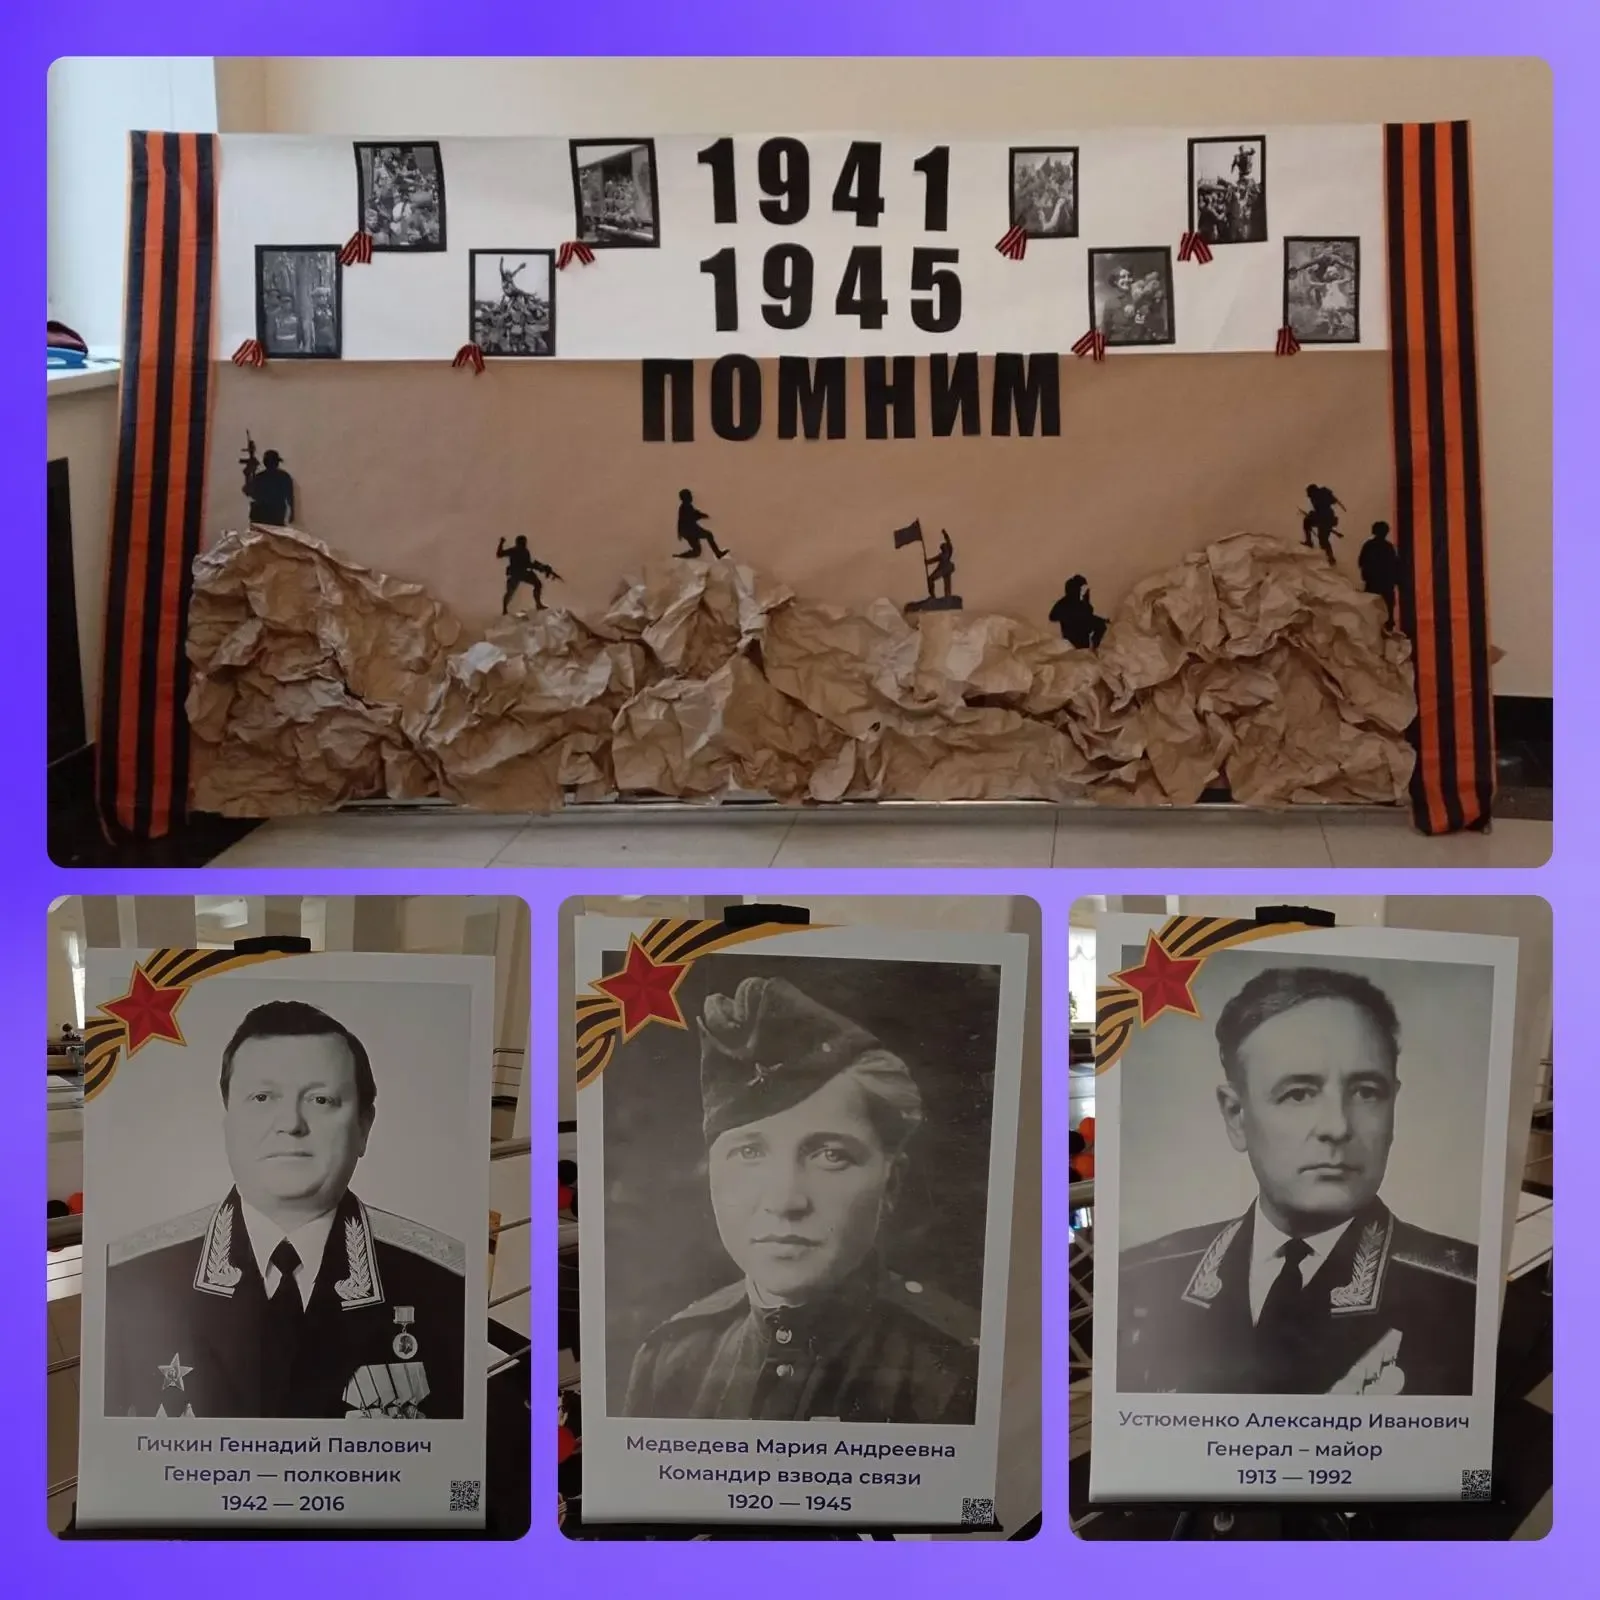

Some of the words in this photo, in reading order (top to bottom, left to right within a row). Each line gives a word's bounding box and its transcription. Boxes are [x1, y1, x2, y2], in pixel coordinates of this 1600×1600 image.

[698, 136, 949, 231] 1941
[700, 243, 961, 332] 1945
[642, 352, 1060, 442] ПОМНИМ
[1119, 1411, 1240, 1428] Устюменко
[1245, 1413, 1363, 1430] Александр
[1368, 1413, 1470, 1429] Иванович
[137, 1435, 212, 1452] Гичкин
[220, 1436, 321, 1453] Геннадий
[328, 1437, 432, 1453] Павлович
[626, 1435, 749, 1455] Медведева
[756, 1438, 828, 1458] Мария
[833, 1441, 956, 1458] Андреевна
[1207, 1441, 1293, 1461] Генерал
[1315, 1440, 1383, 1461] майор
[164, 1465, 251, 1486] Генерал
[284, 1470, 401, 1483] полковник
[659, 1464, 771, 1486] Командир
[778, 1470, 853, 1486] взвода
[859, 1472, 921, 1486] связи
[1237, 1469, 1277, 1485] 1913
[1308, 1469, 1353, 1485] 1992
[221, 1495, 268, 1511] 1942
[299, 1495, 345, 1512] 2016
[727, 1494, 774, 1510] 1920
[805, 1495, 852, 1512] 1945
